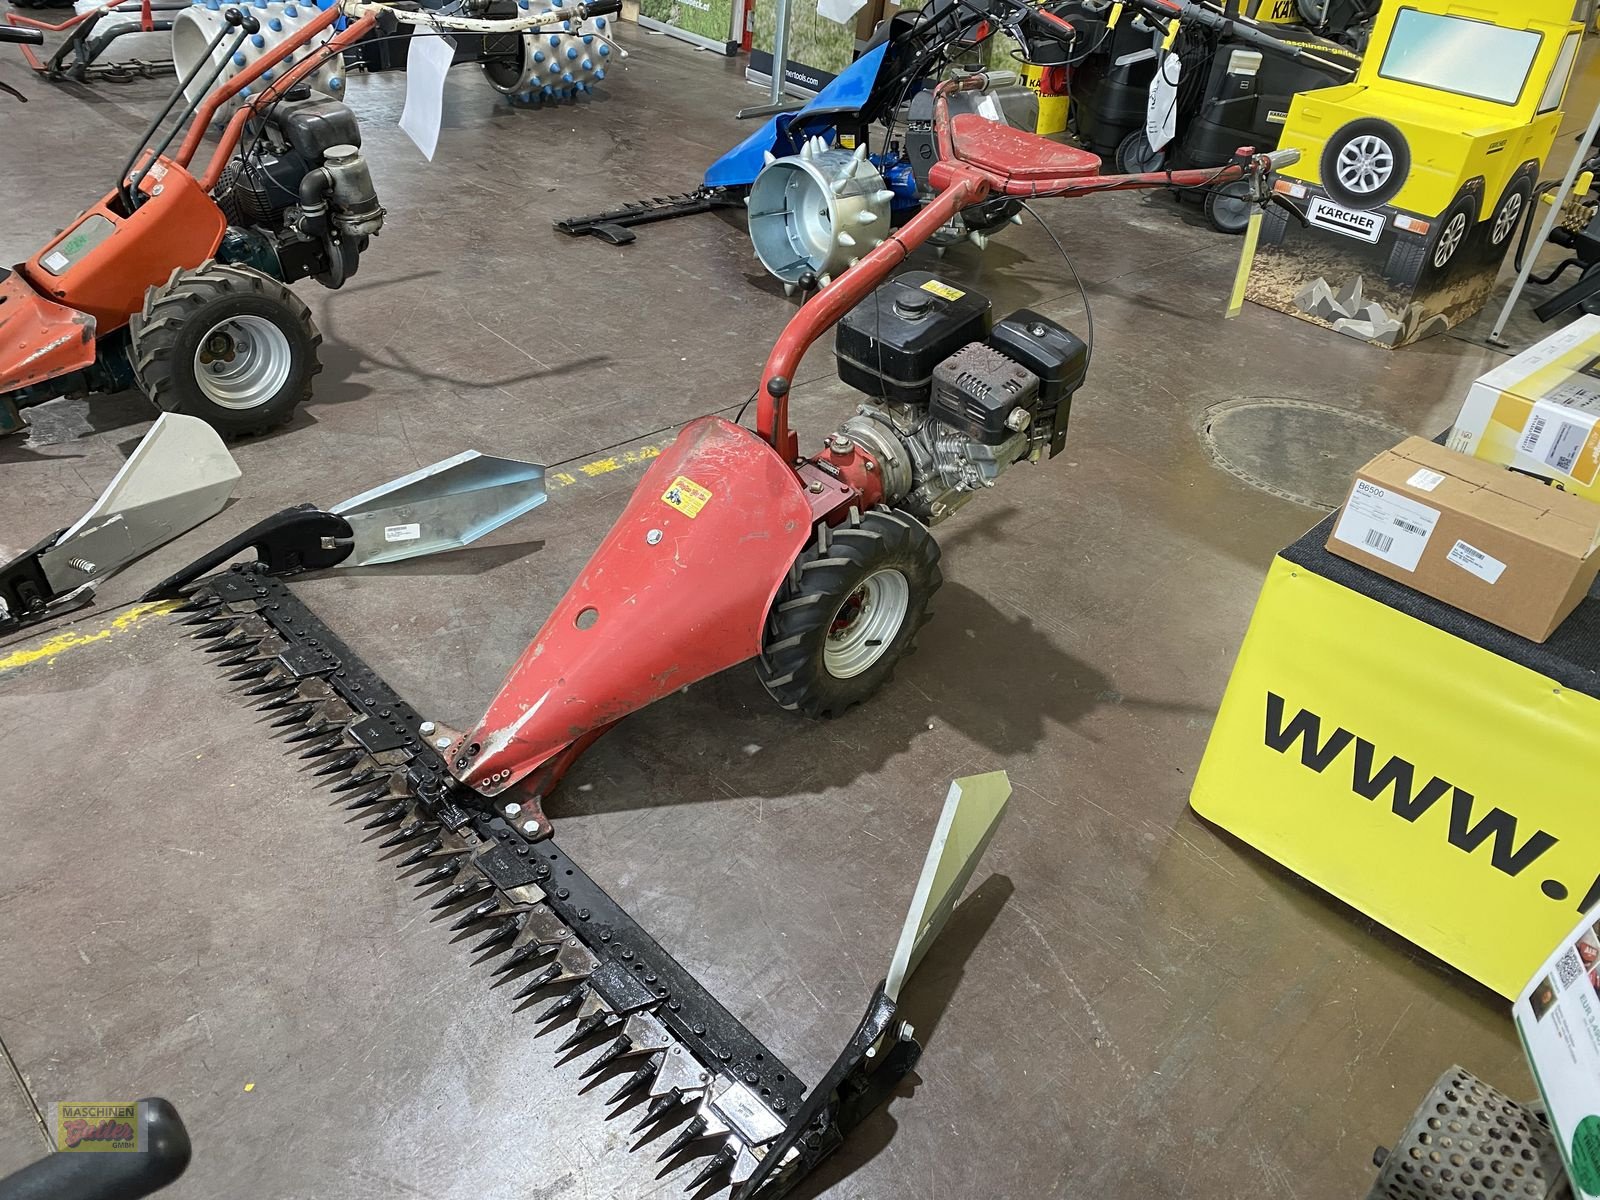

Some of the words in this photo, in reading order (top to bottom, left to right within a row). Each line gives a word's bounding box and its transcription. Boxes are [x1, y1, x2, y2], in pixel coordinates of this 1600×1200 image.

[1029, 78, 1041, 88] KÄ
[1317, 204, 1375, 229] KÄRCHER
[1358, 482, 1385, 498] B6500
